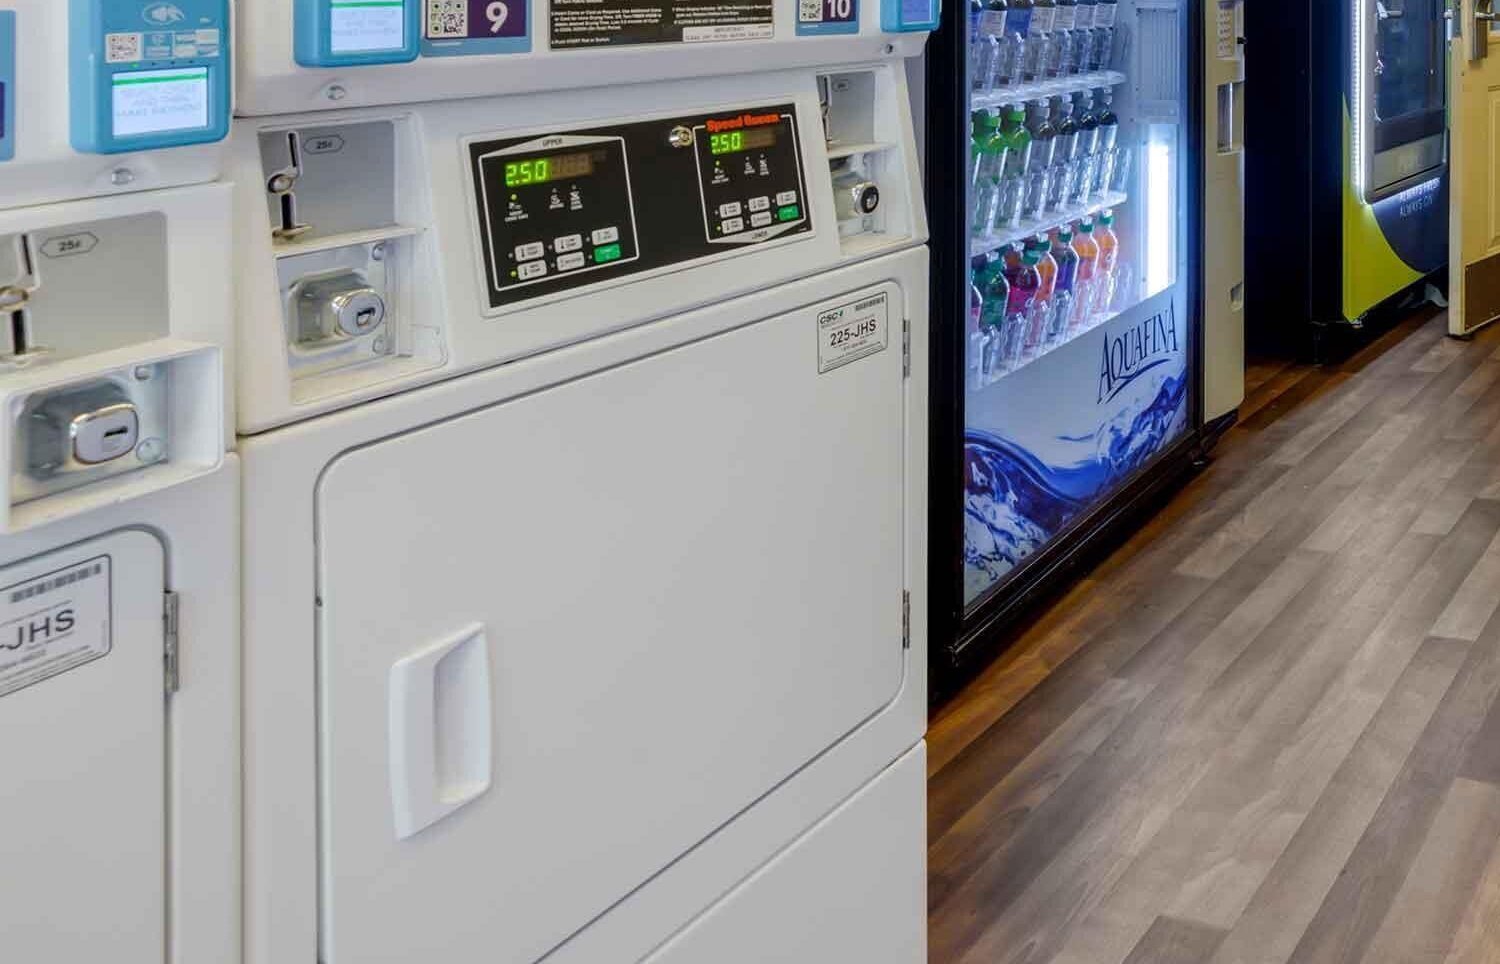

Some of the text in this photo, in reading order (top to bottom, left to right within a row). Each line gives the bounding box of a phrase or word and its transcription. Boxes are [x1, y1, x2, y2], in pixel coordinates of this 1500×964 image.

[485, 1, 508, 33] 9
[706, 113, 780, 132] Speed Queen
[542, 138, 564, 148] UPPER
[711, 132, 742, 155] 2.50
[505, 159, 547, 186] 2.50
[819, 311, 840, 325] CSC
[830, 319, 877, 347] 225-JHS
[1097, 295, 1178, 404] AQUAFINA
